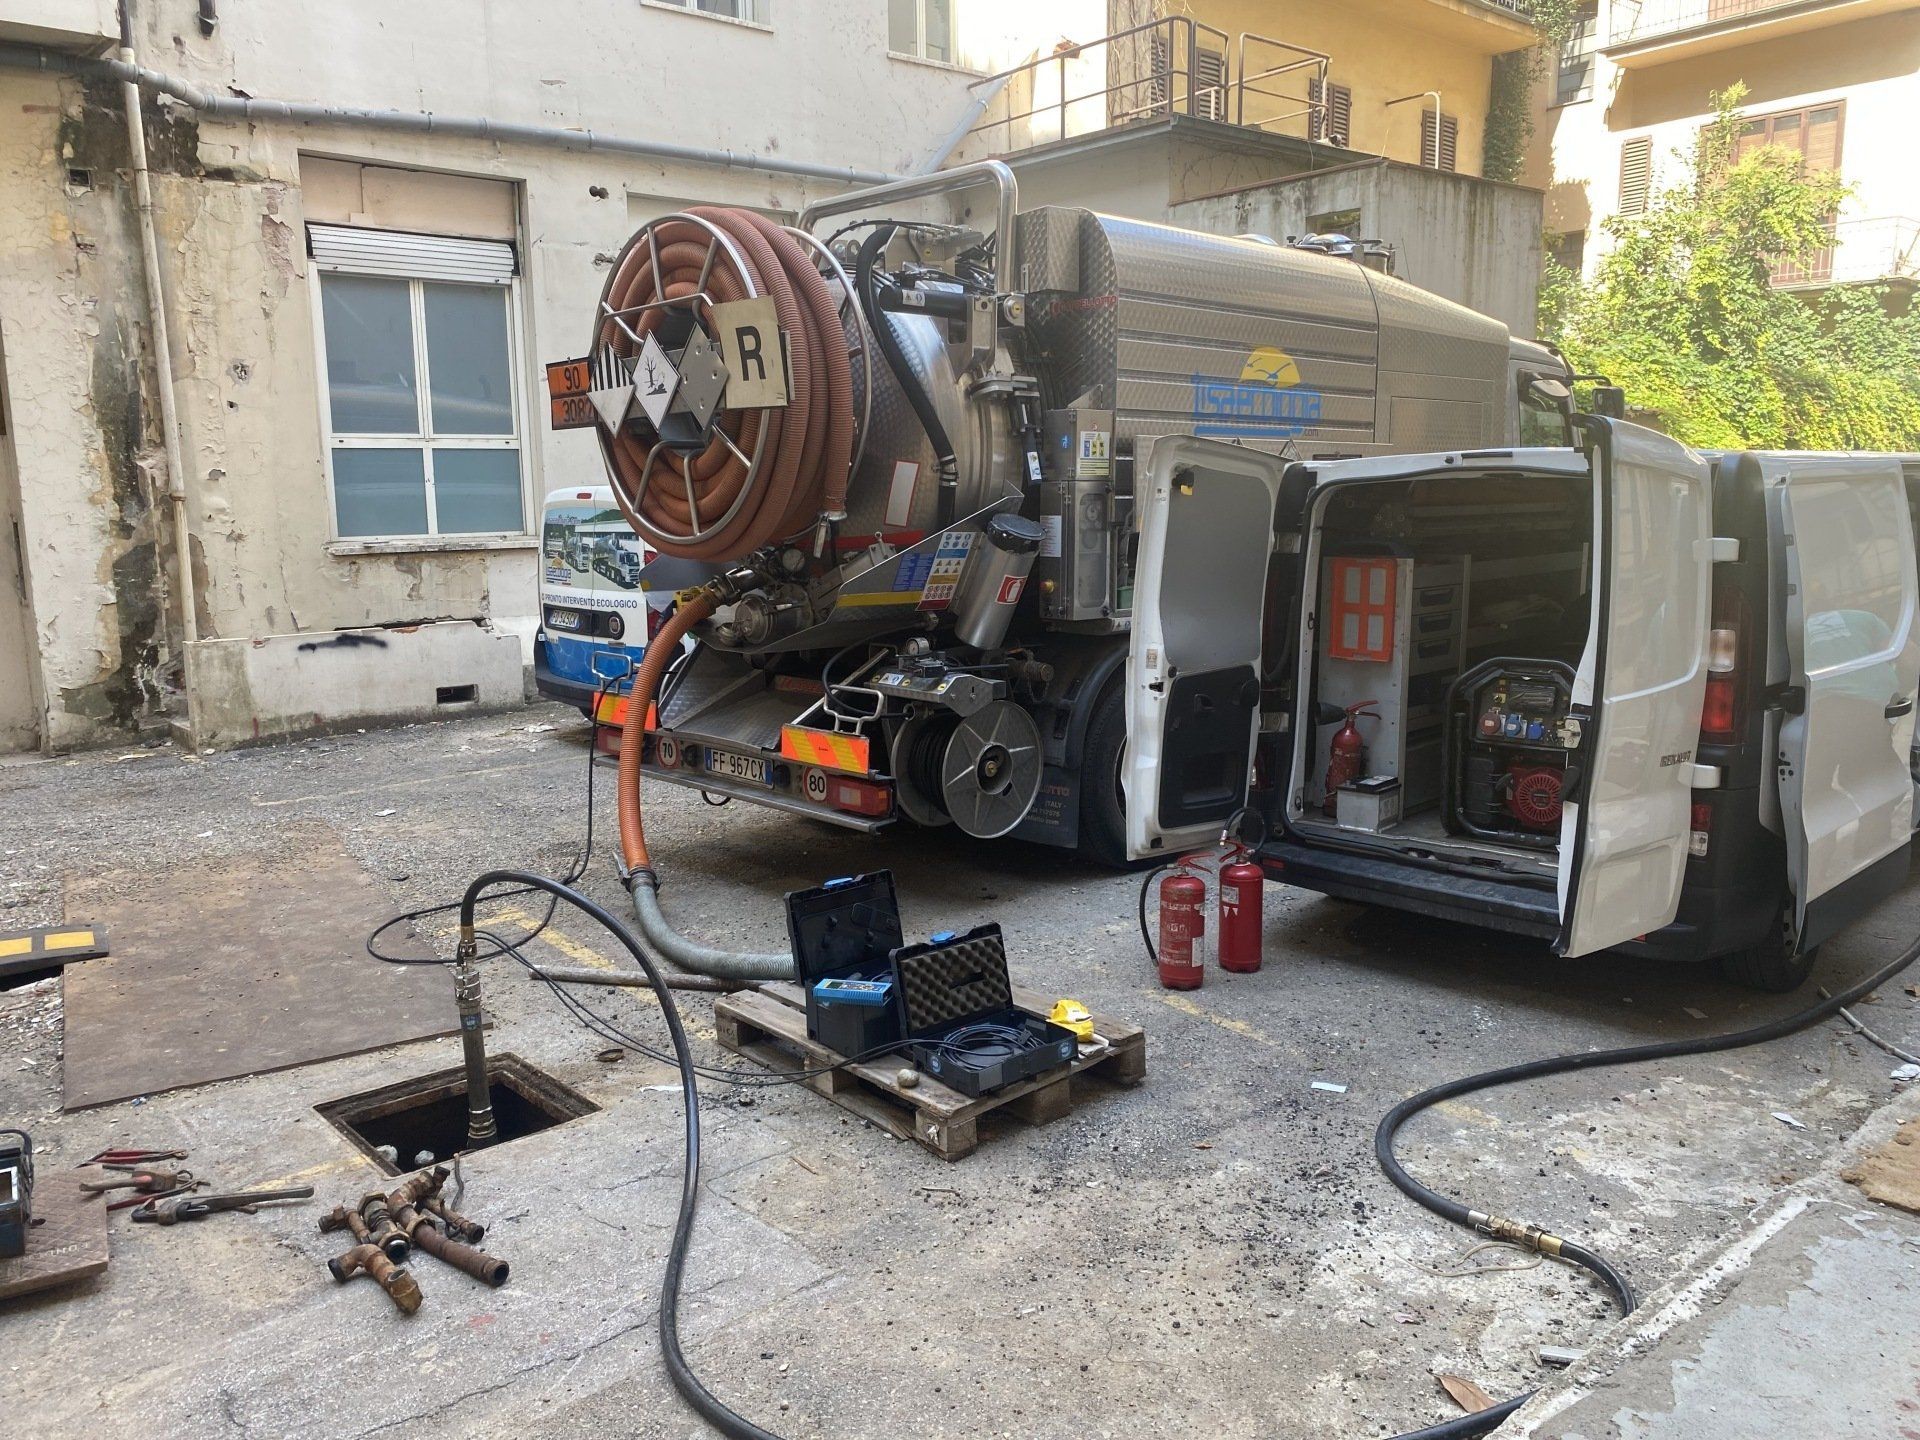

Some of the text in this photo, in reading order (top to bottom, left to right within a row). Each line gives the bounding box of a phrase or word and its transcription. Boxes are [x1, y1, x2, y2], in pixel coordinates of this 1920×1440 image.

[735, 325, 767, 382] R
[564, 365, 581, 390] 90
[562, 595, 595, 607] INTERVENTO
[596, 598, 638, 609] ECOLOGICO
[662, 742, 673, 759] 70
[712, 751, 765, 781] FF 967CX
[809, 775, 826, 793] 80
